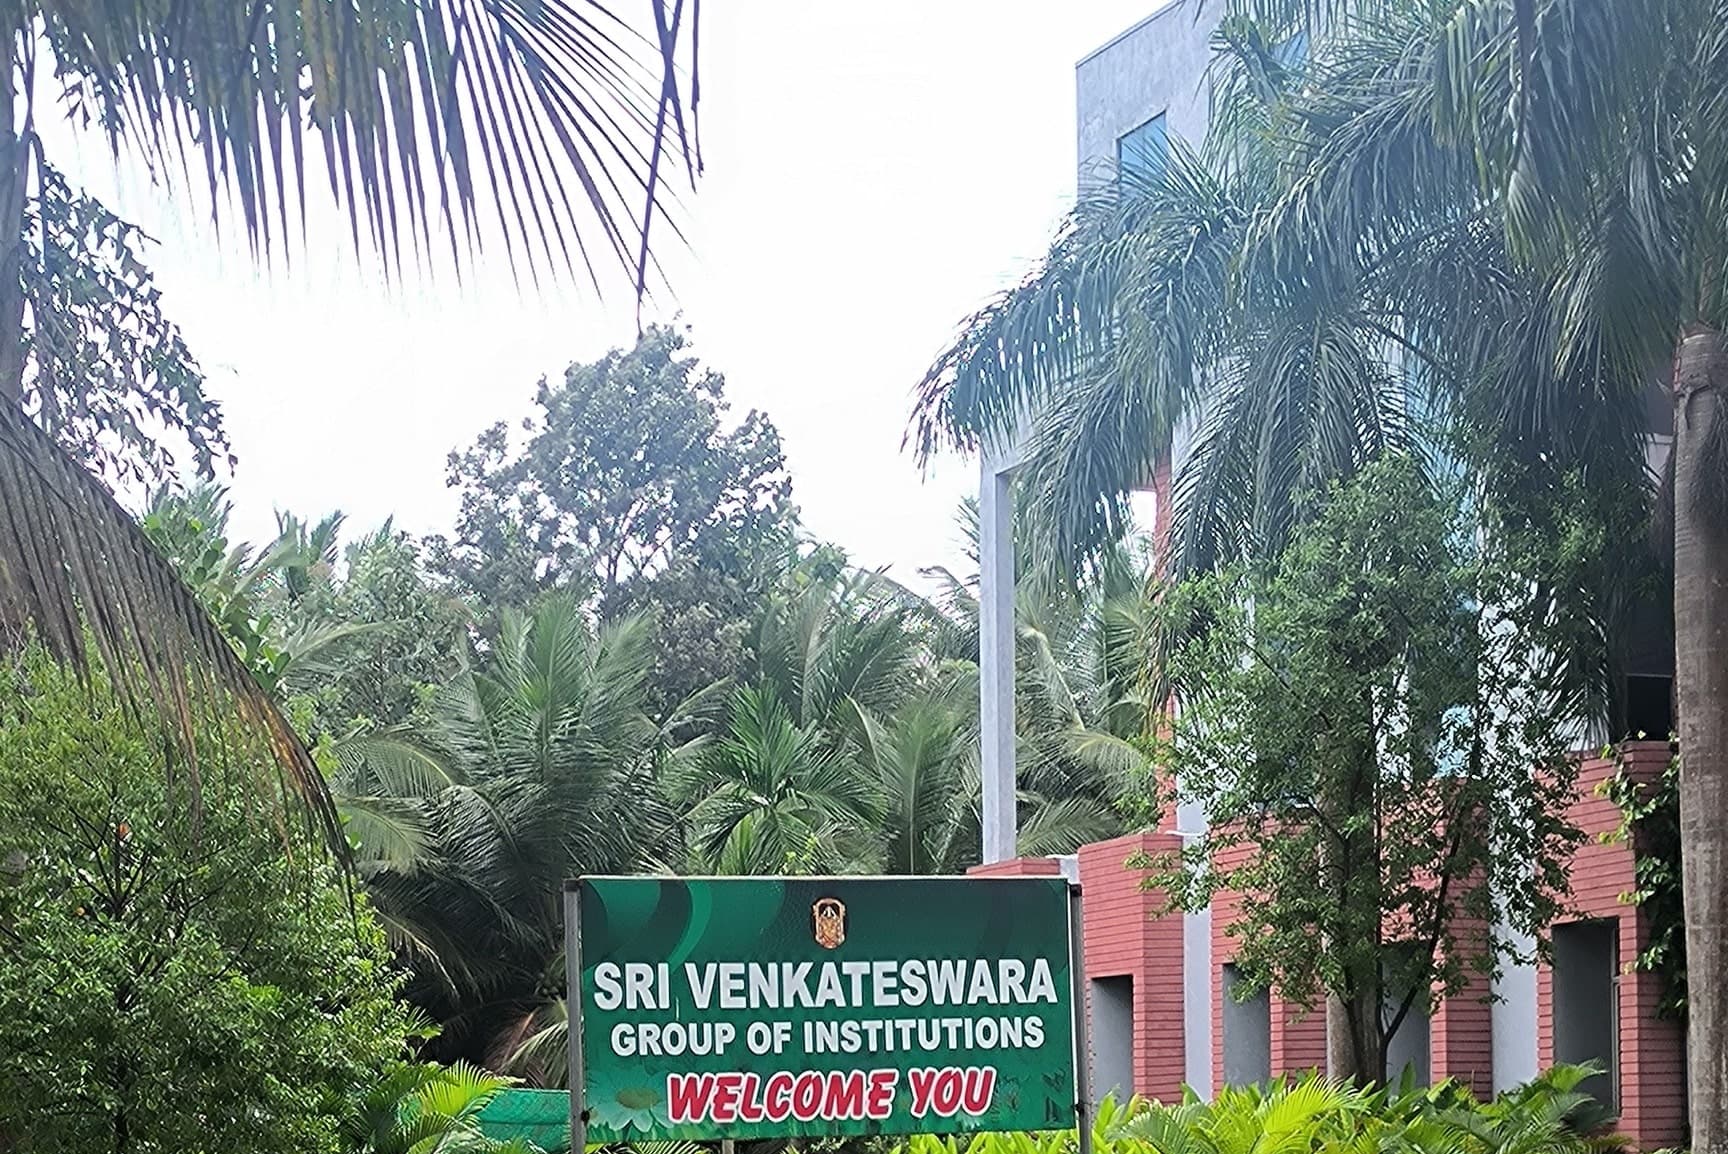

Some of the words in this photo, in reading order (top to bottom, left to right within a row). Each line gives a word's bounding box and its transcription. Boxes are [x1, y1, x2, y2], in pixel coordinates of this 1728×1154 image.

[594, 961, 670, 1010] SRI
[685, 958, 1058, 1009] VENKATESWARA
[610, 1021, 736, 1057] GROUP
[746, 1019, 792, 1054] OF
[804, 1016, 1045, 1053] INSTITUTIONS
[666, 1067, 898, 1123] WELCOME
[908, 1065, 997, 1118] YOU
